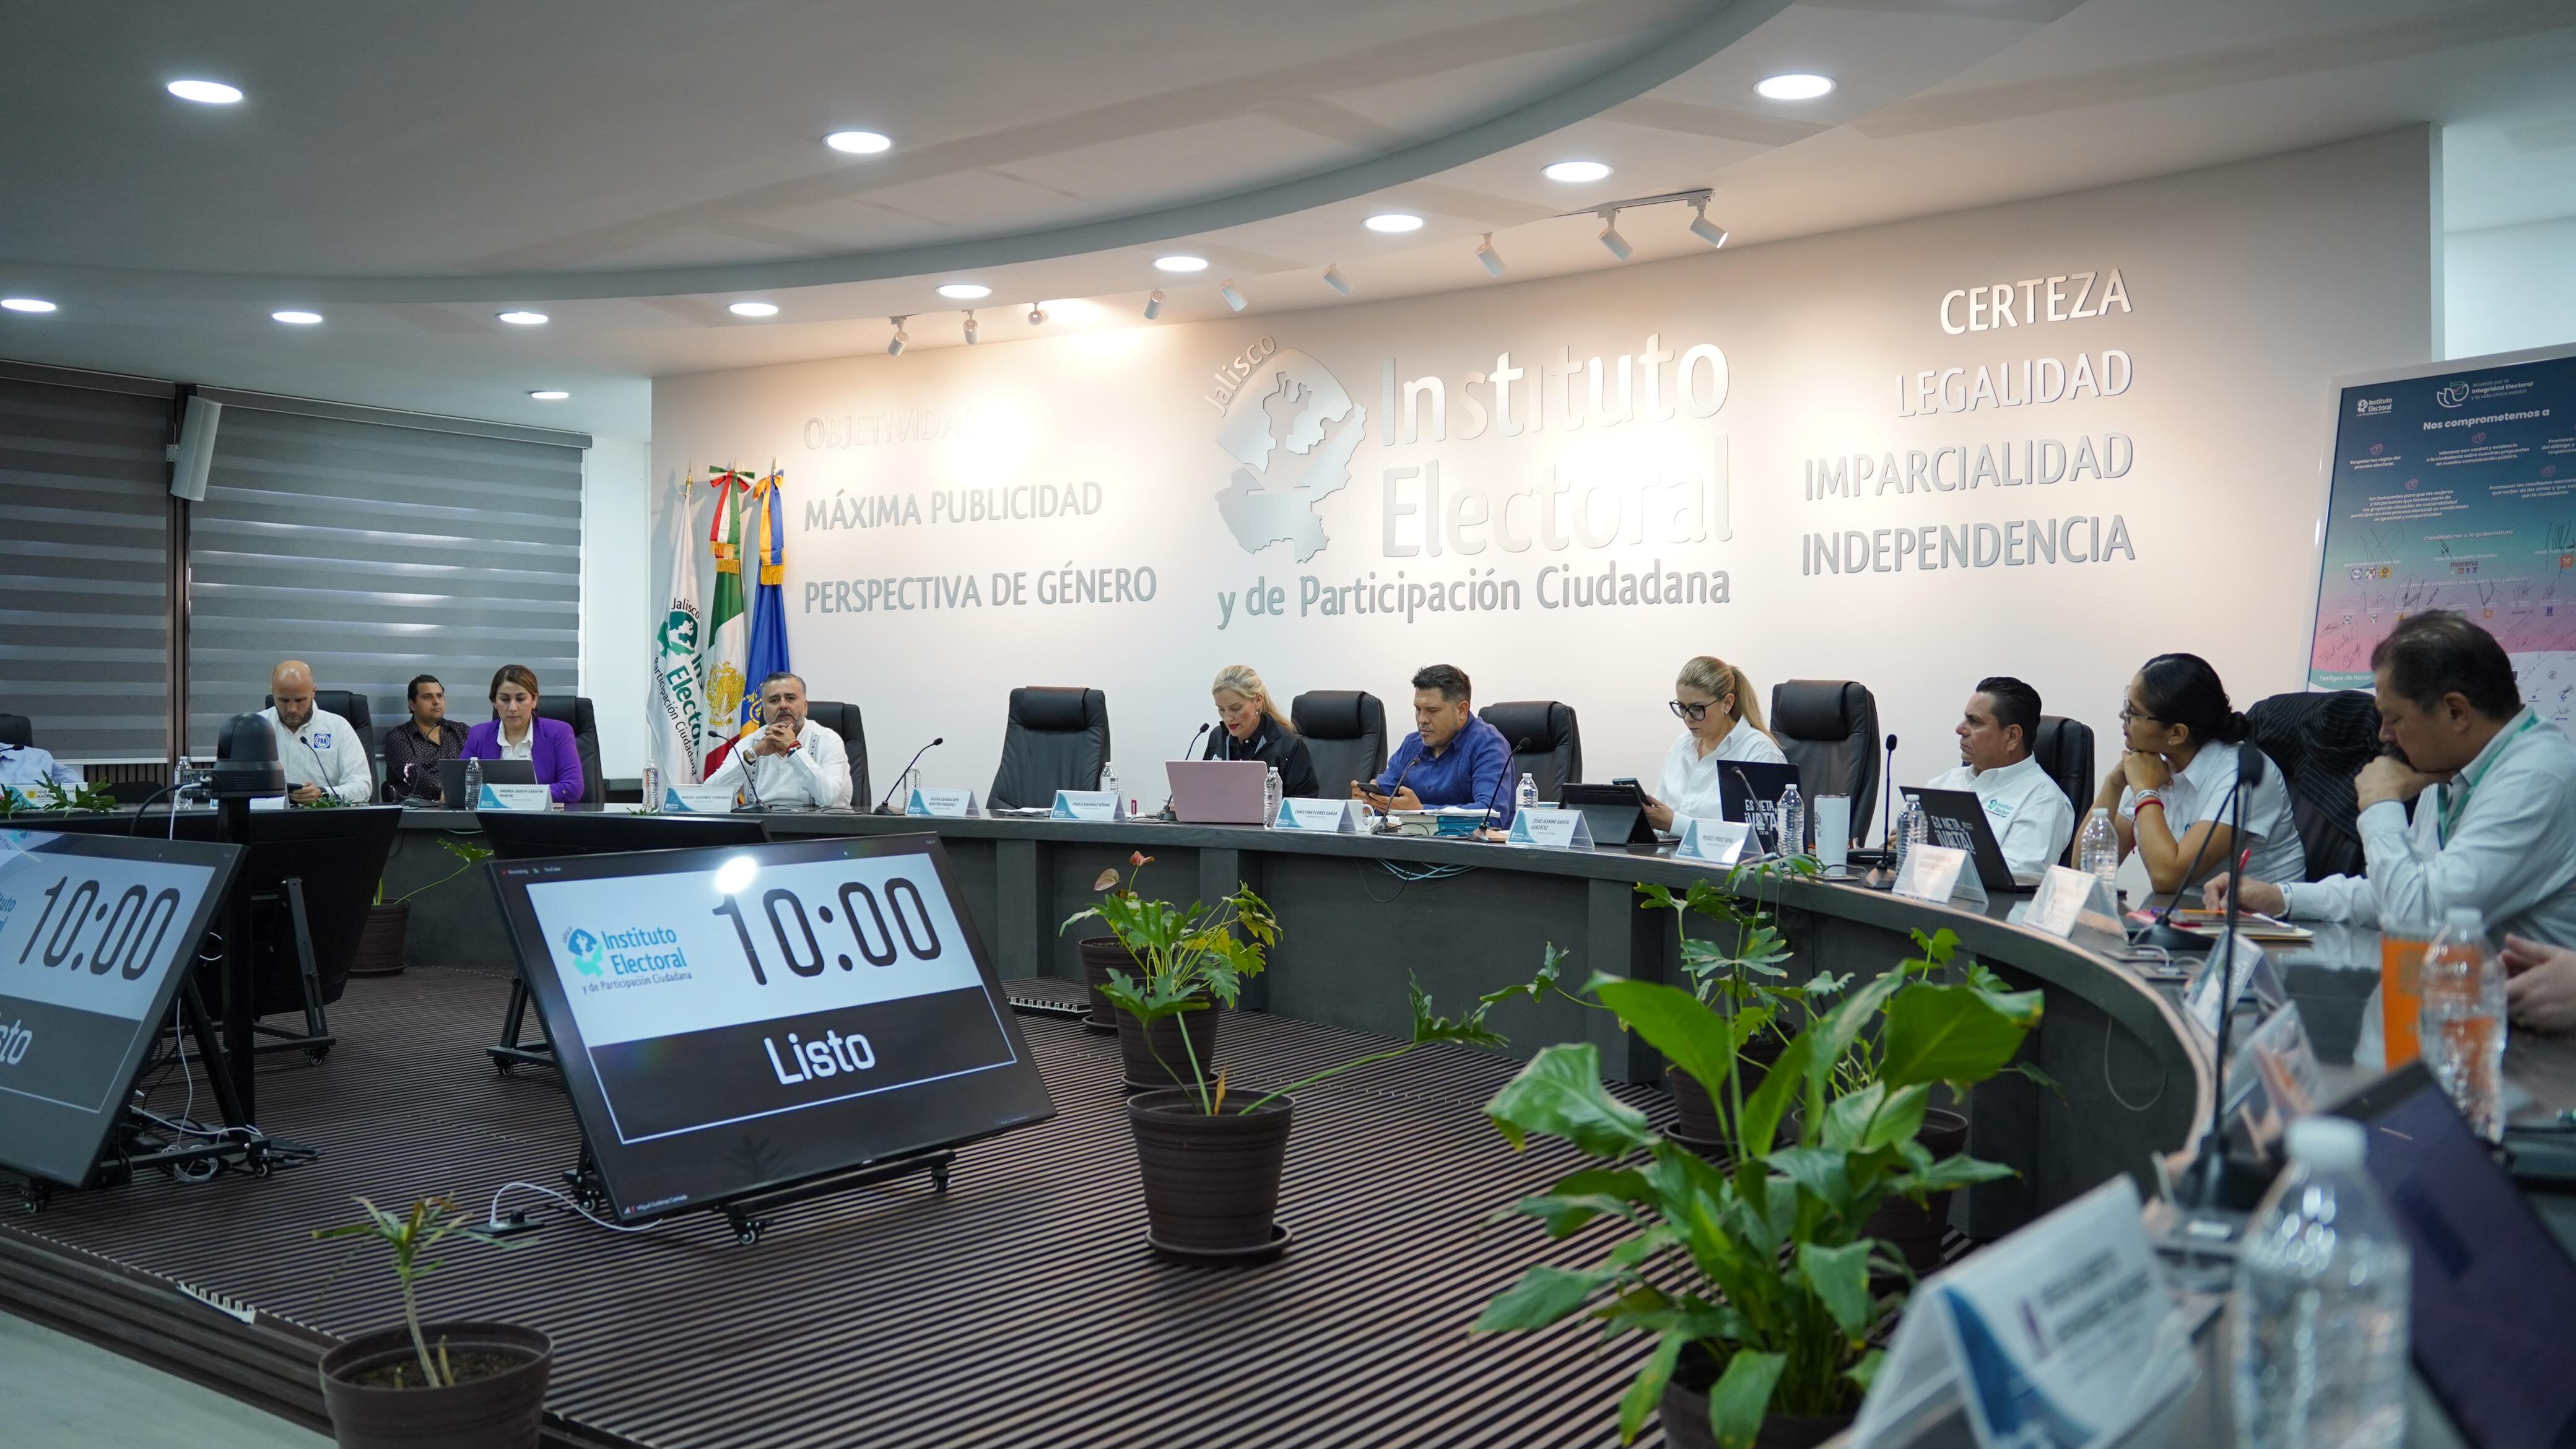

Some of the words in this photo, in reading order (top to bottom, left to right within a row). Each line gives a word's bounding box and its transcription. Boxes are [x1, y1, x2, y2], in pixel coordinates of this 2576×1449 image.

[1940, 268, 2133, 334] CERTEZA
[1203, 333, 1276, 417] Jalisco
[1382, 333, 1730, 447] Instituto
[1895, 349, 2133, 417] LEGALIDAD
[2471, 384, 2504, 394] Integridad
[2505, 381, 2533, 390] Electoral
[2368, 404, 2392, 412] Electoral
[2423, 421, 2443, 430] Nos
[2444, 410, 2539, 428] comprometemos
[2541, 409, 2550, 417] a
[1805, 432, 2133, 500] IMPARCIALIDAD
[804, 489, 921, 531] MÁXIMA
[931, 481, 1103, 524] PUBLICIDAD
[1382, 433, 1733, 557] Electoral
[1803, 515, 2135, 576] INDEPENDENCIA
[2476, 529, 2513, 537] gubernatura
[805, 575, 981, 613] PERSPECTIVA
[991, 572, 1027, 606] DE
[1037, 560, 1157, 605] GÉNERO
[2450, 560, 2478, 568] morena
[2502, 575, 2528, 583] políticos
[671, 597, 700, 619] Jalisco
[1217, 590, 1236, 630] y
[1245, 575, 1286, 616] de
[1299, 567, 1520, 624] Participación
[1536, 559, 1730, 609] Ciudadana
[653, 656, 679, 721] Participación
[675, 721, 698, 777] Ciudadana
[1745, 799, 1754, 812] ES
[1930, 815, 1943, 829] ES
[19, 876, 180, 981] 10:00
[601, 926, 677, 951] Instituto
[711, 877, 942, 987] 10:00
[581, 985, 587, 994] y
[589, 982, 599, 992] de
[600, 975, 651, 990] Participación
[652, 972, 692, 983] Ciudadana
[611, 946, 687, 975] Electoral
[764, 1028, 876, 1086] Listo
